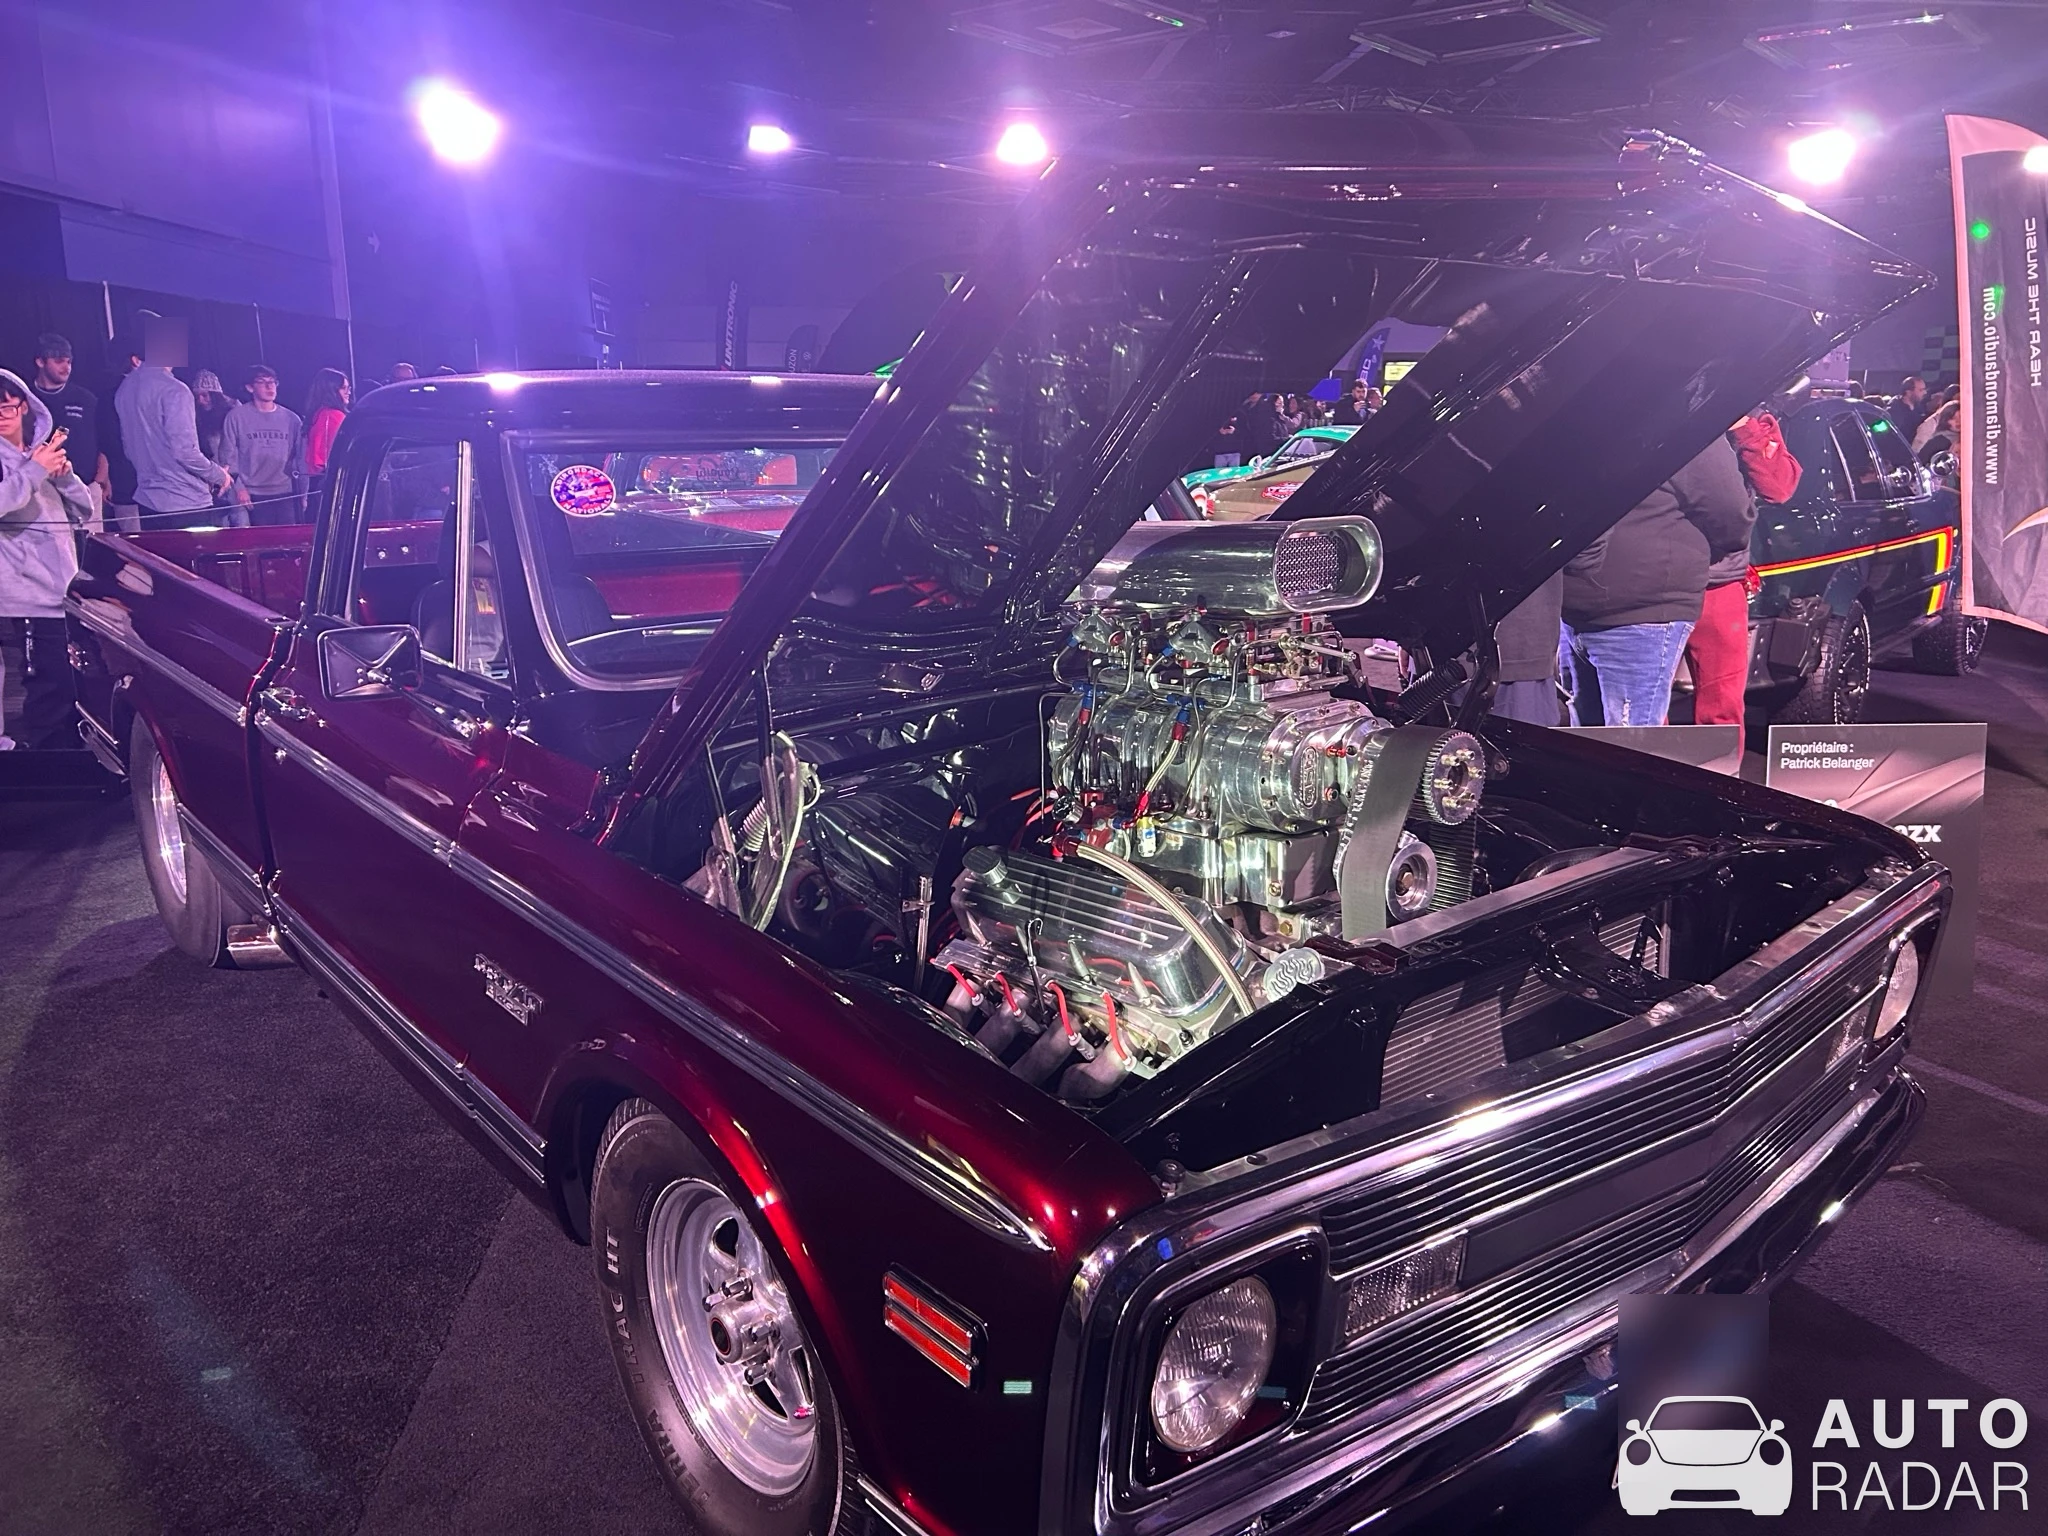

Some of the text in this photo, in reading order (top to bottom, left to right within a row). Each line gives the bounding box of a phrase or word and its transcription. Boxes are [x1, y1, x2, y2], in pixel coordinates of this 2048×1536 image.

[724, 280, 738, 367] UNITRONIC
[563, 494, 613, 514] NATIONALS
[1781, 757, 1875, 770] Patrick Belanger
[606, 1226, 621, 1274] HT
